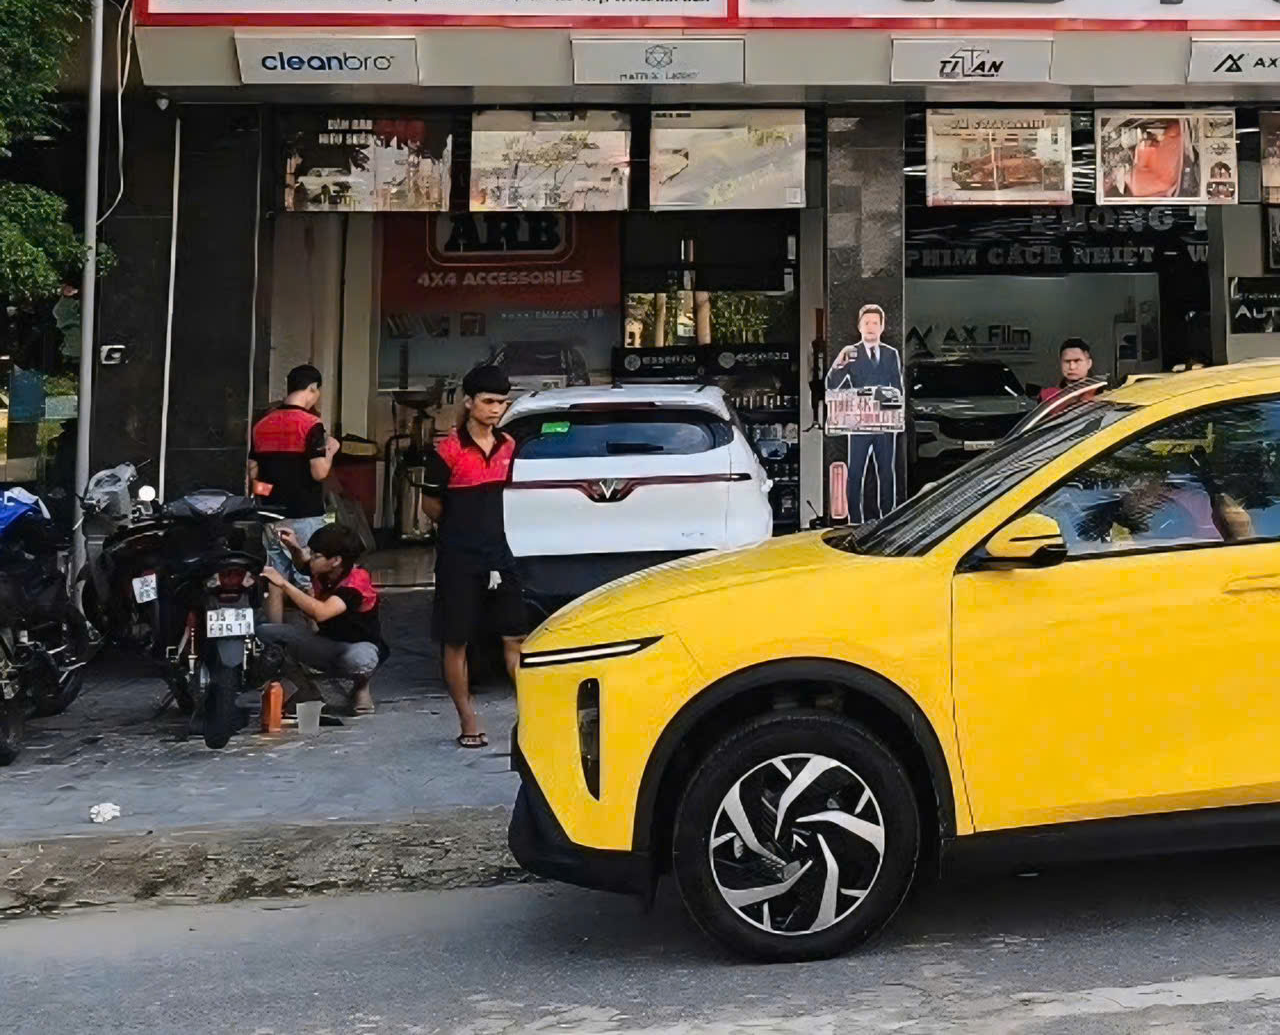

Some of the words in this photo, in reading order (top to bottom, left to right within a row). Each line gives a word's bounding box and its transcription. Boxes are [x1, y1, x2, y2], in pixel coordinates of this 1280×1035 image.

[261, 51, 392, 71] cleanbro
[1253, 57, 1279, 68] AX
[462, 270, 585, 286] ACCESSORIES
